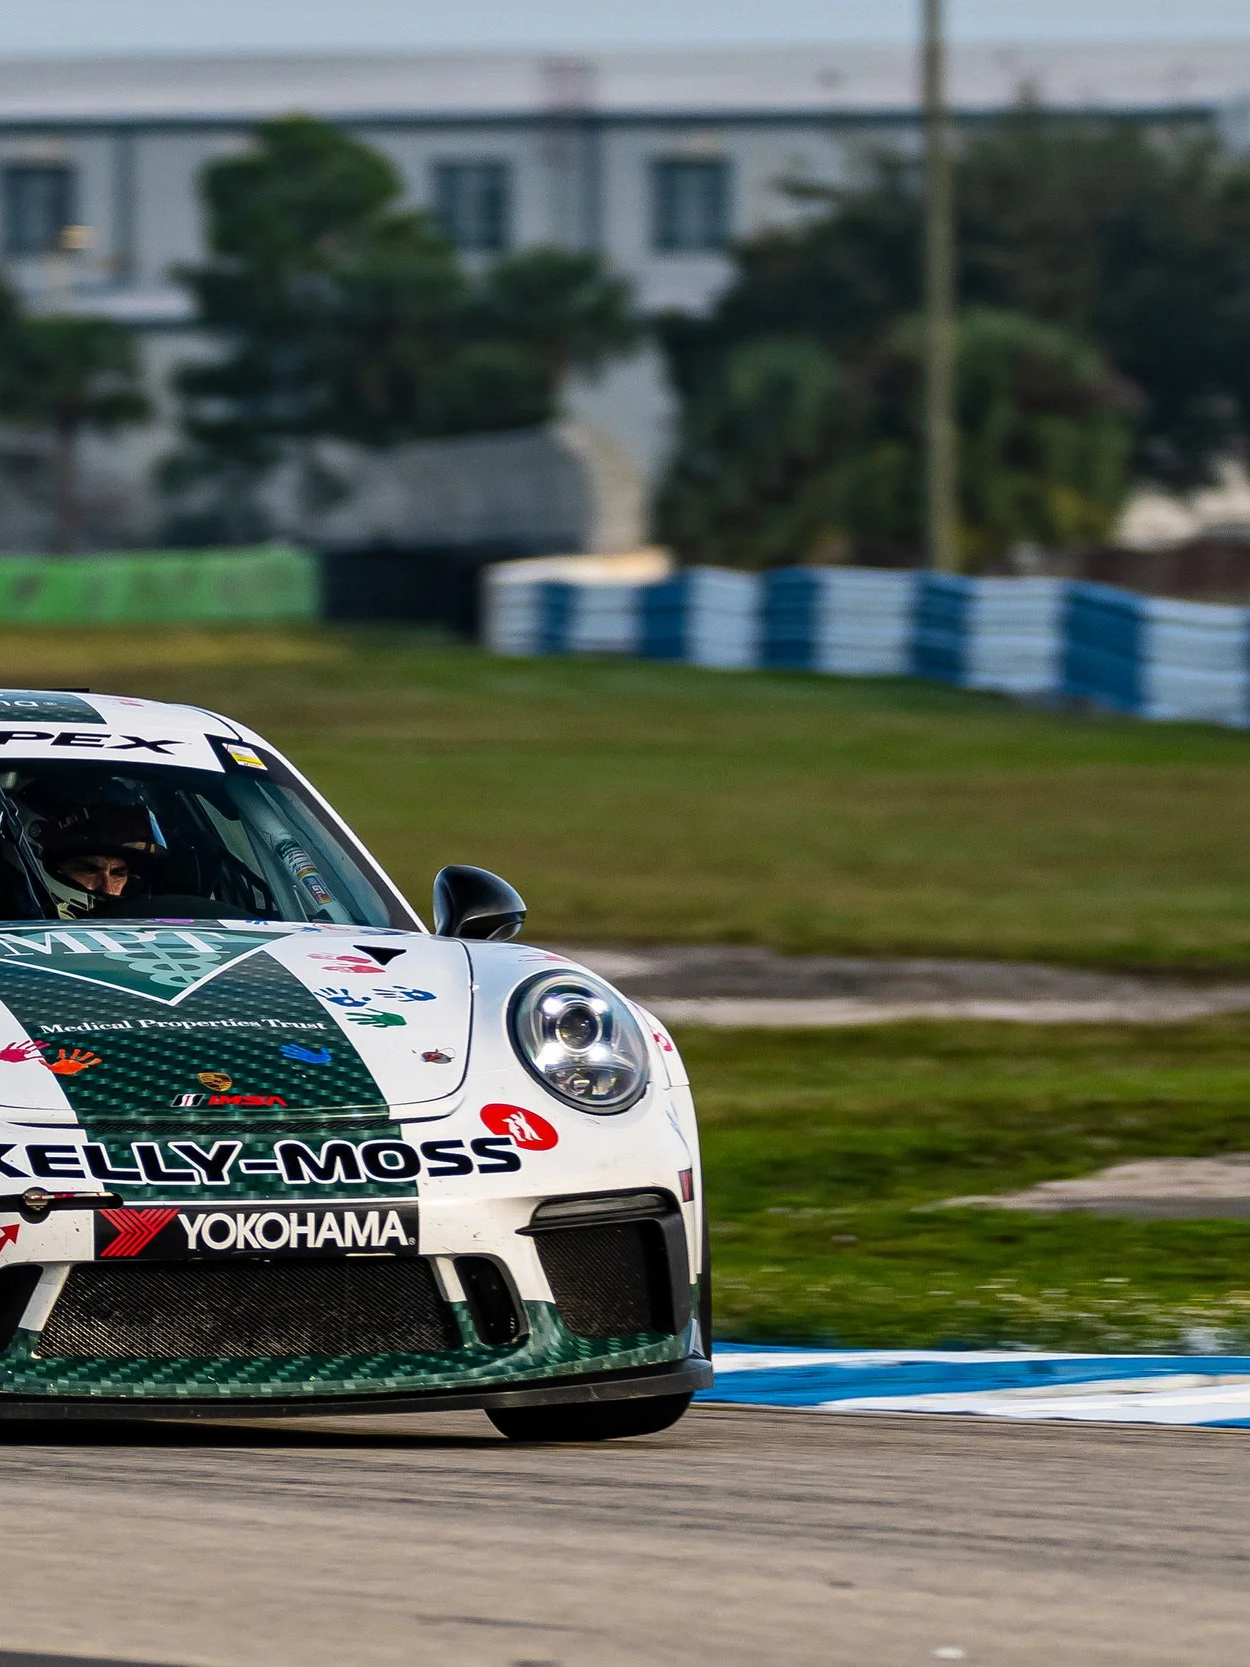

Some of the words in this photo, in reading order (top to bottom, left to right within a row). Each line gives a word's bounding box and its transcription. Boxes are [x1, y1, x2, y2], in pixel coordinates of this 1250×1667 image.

[40, 1019, 134, 1034] Medical
[136, 1018, 260, 1031] Properties
[261, 1018, 328, 1031] Trust
[206, 1095, 288, 1107] IMSA
[177, 1210, 409, 1250] YOKOHAMA
